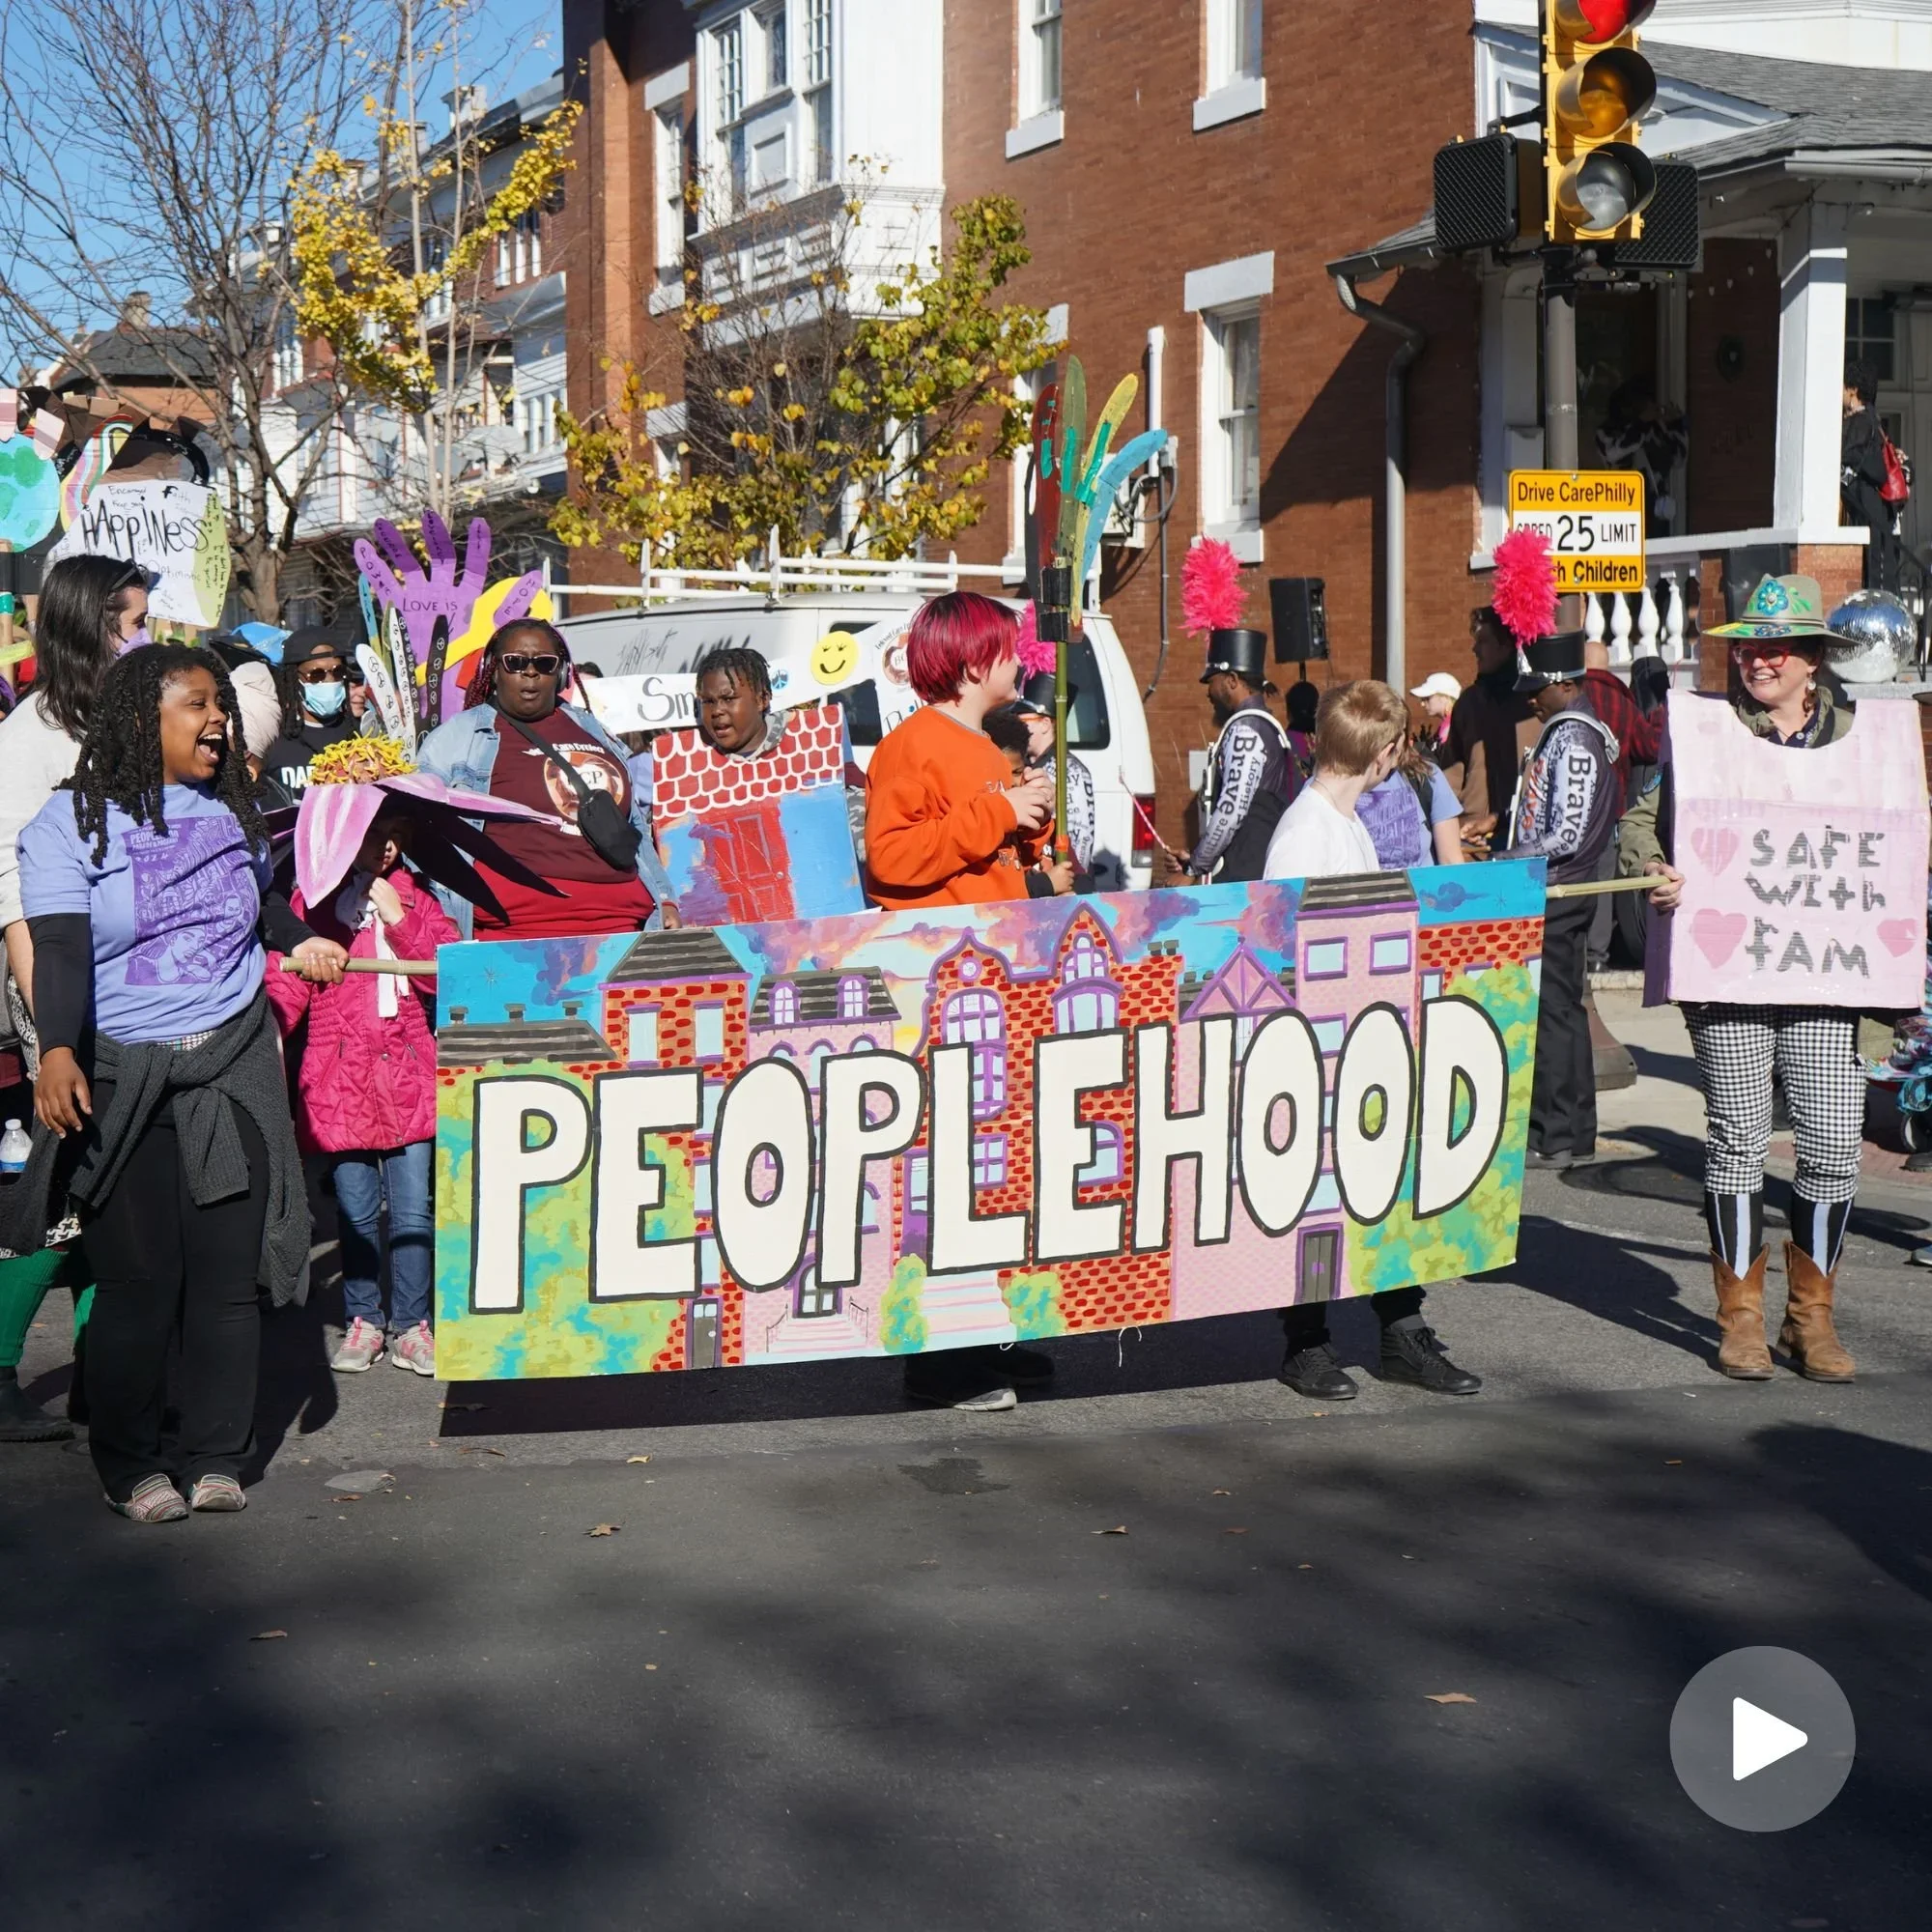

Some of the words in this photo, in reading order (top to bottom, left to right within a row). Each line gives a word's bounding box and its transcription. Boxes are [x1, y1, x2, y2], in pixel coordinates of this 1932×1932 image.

[1518, 482, 1554, 502] Drive
[1559, 482, 1635, 506] CarePhilly
[1557, 515, 1595, 552] 25
[1601, 524, 1636, 542] LIMIT
[1574, 560, 1637, 582] Children
[402, 598, 438, 612] LOVE
[1219, 734, 1258, 816] Brave
[1238, 756, 1261, 814] History
[1561, 754, 1592, 845] Brave
[1749, 825, 1886, 869] SAFE
[469, 996, 1509, 1315] PEOPLEHOOD
